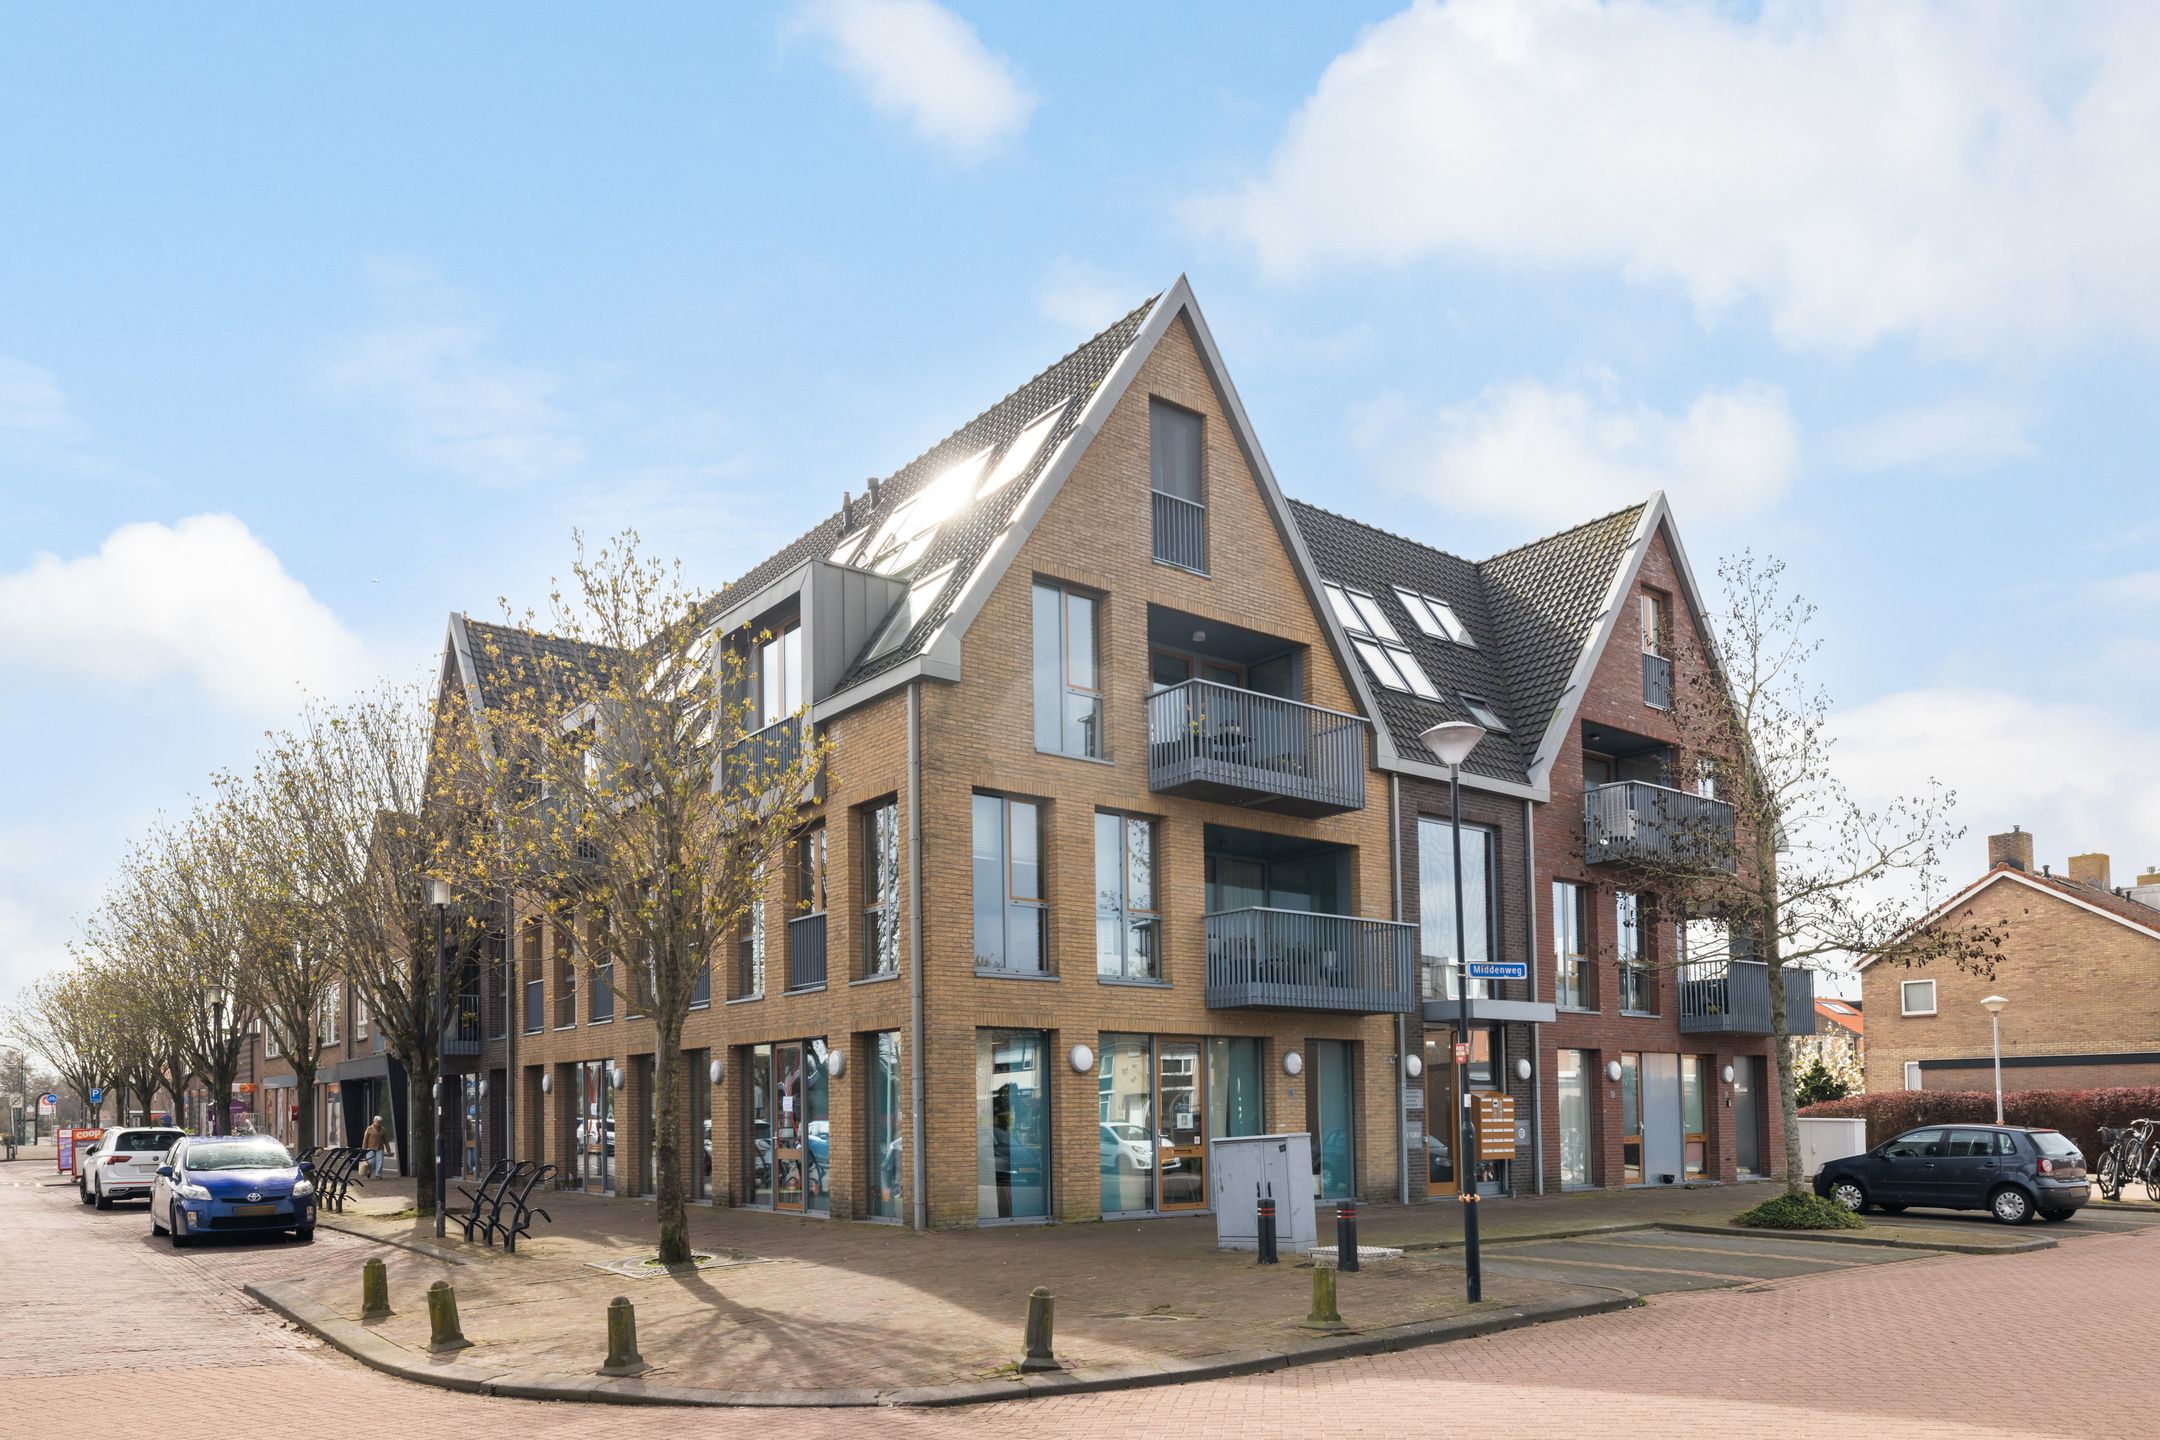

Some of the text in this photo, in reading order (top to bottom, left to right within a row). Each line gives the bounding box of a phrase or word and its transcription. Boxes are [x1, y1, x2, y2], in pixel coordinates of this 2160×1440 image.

[1473, 965, 1521, 976] Middenweg
[92, 1089, 99, 1097] P
[76, 1130, 101, 1139] coop
